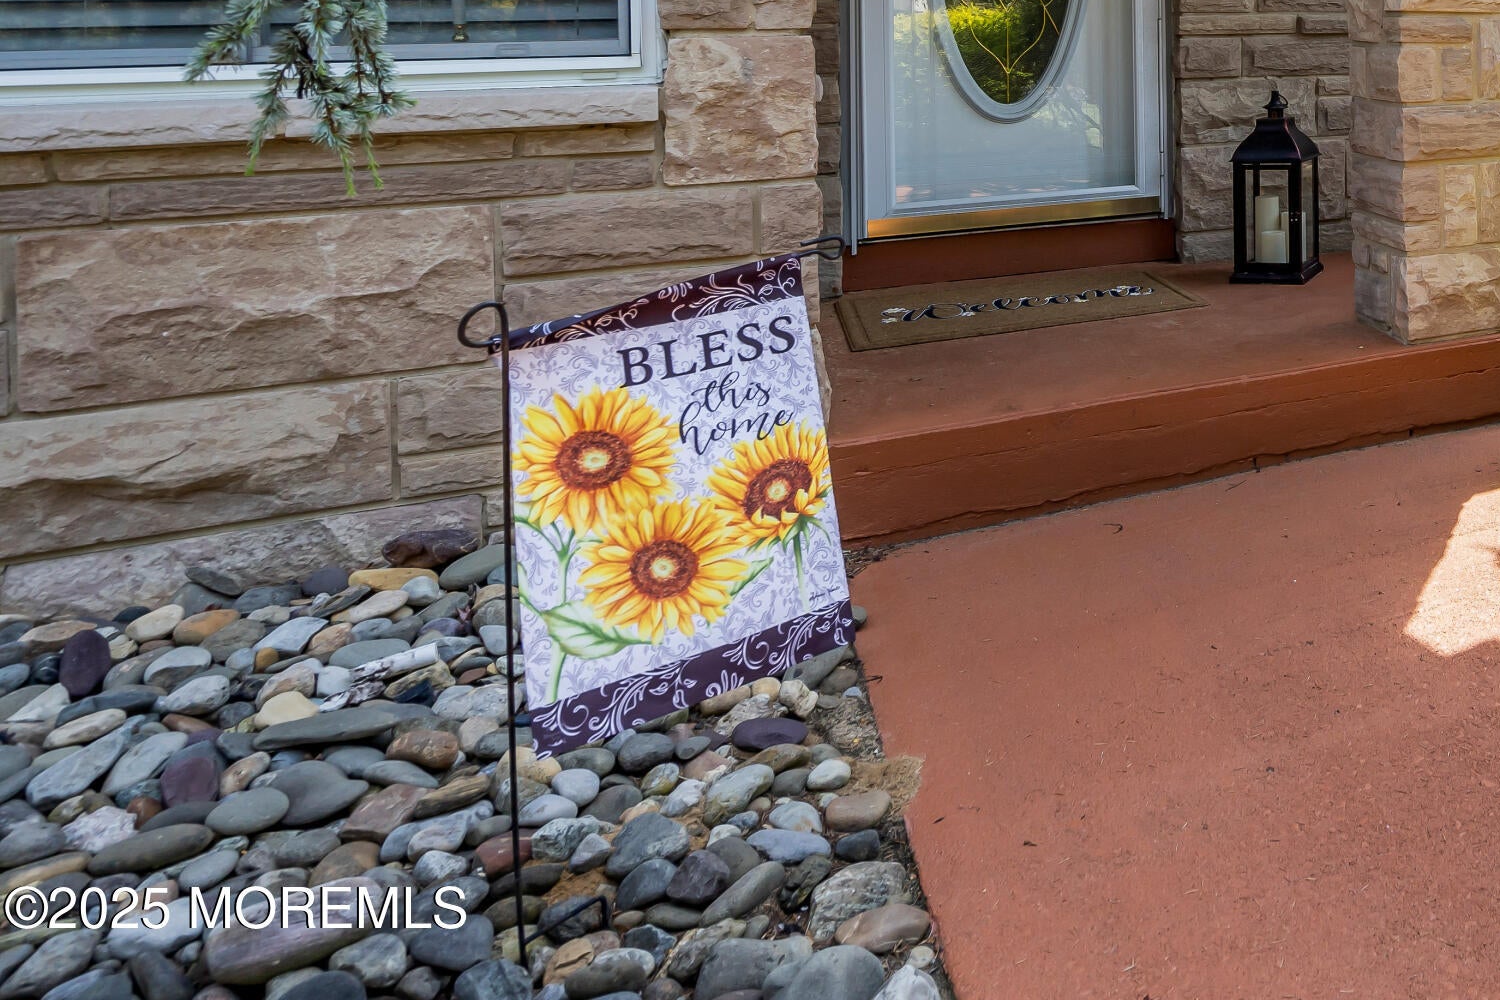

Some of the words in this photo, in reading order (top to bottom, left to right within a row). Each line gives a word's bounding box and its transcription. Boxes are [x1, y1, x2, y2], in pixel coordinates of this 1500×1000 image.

[881, 284, 1155, 325] Welcome
[616, 315, 796, 389] BLESS
[691, 370, 772, 413] this
[679, 400, 793, 456] home
